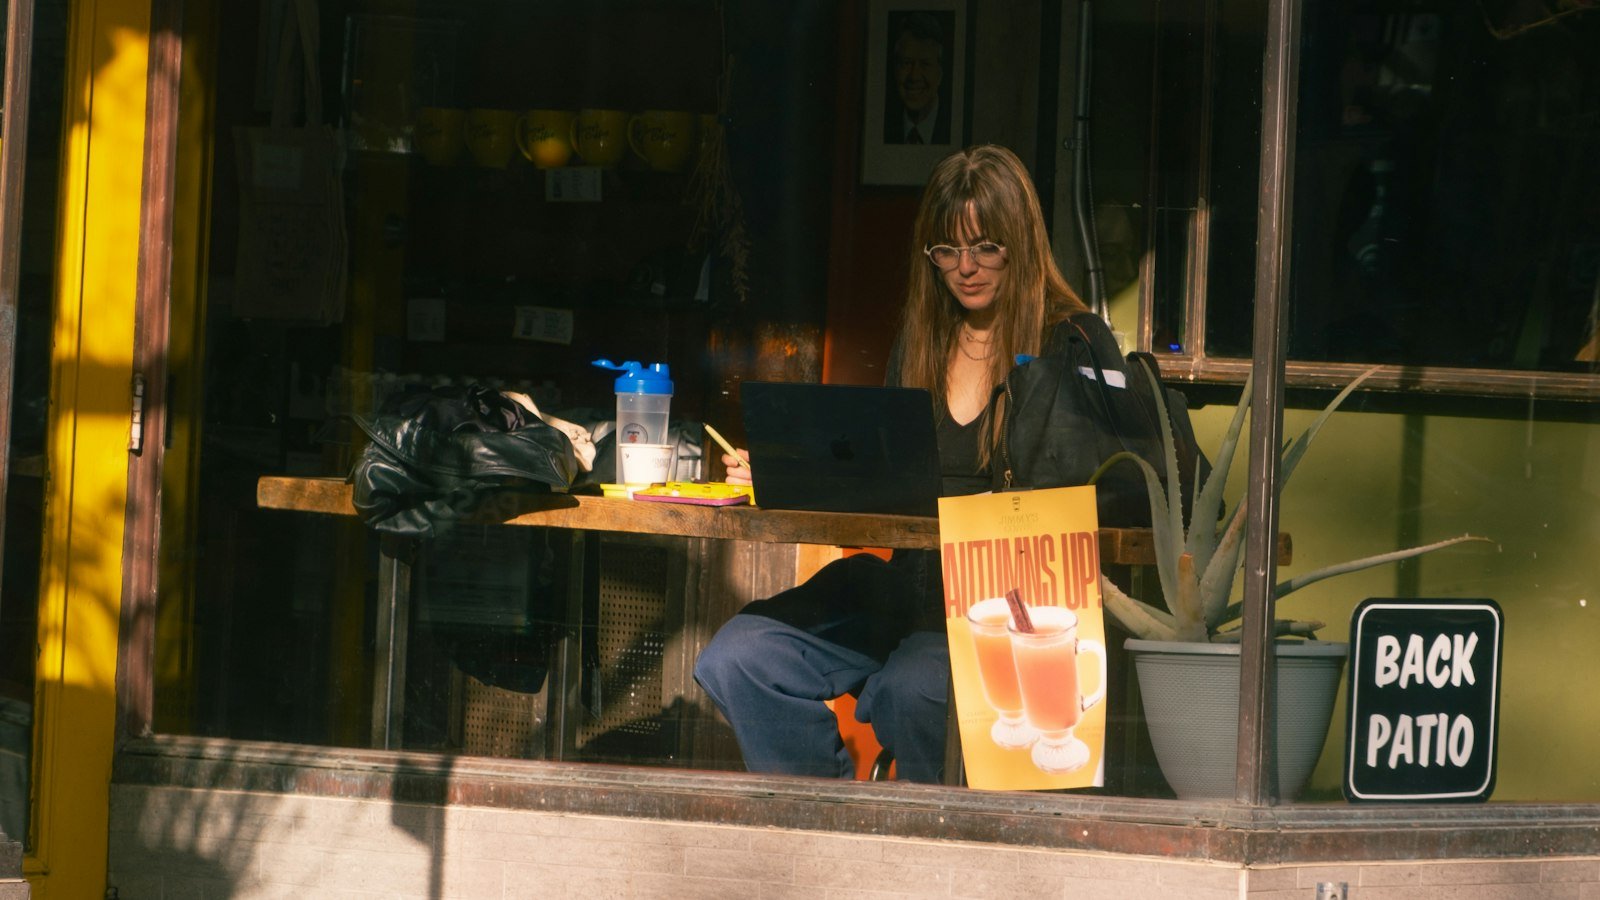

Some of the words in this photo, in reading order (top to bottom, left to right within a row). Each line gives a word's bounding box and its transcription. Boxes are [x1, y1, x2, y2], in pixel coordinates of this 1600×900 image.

[998, 512, 1040, 525] JIMMY'S
[943, 533, 1058, 619] AUTUMNS
[1060, 530, 1103, 610] UP!
[1375, 631, 1479, 690] BACK
[1366, 712, 1475, 770] PATIO
